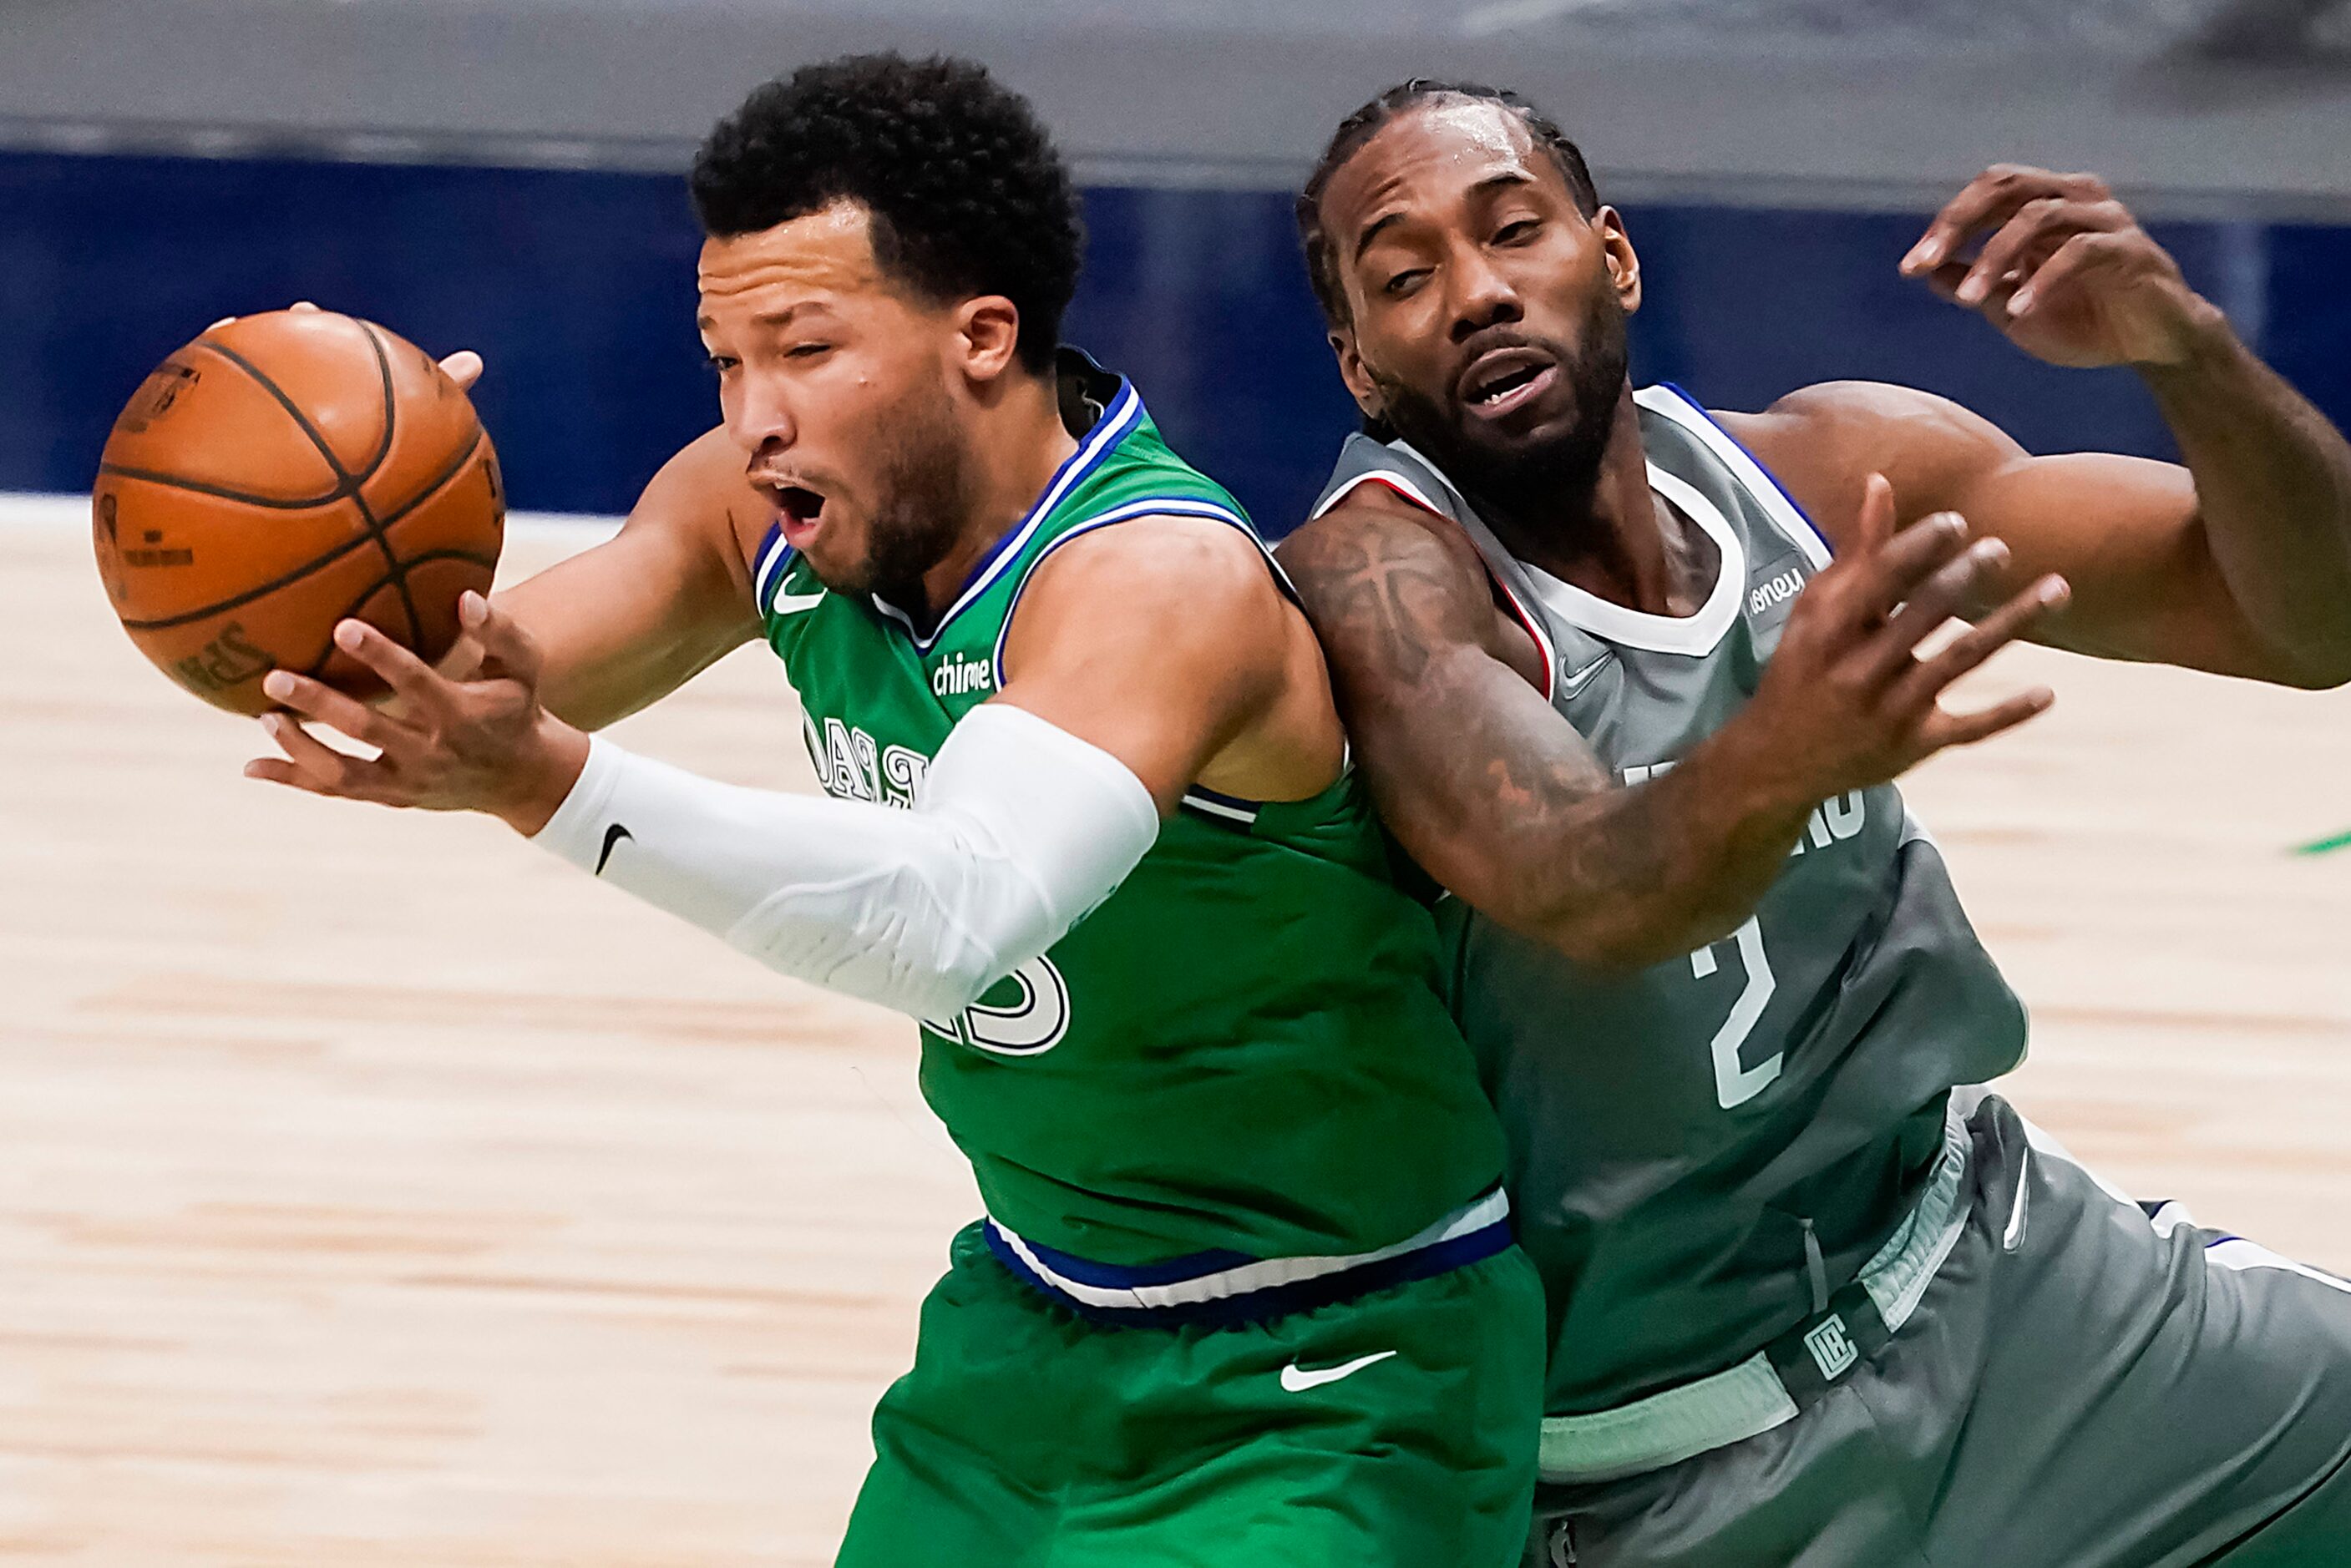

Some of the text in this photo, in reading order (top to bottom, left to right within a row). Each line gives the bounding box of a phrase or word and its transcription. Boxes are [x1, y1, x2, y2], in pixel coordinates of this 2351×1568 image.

[1749, 567, 1806, 615] oney
[933, 651, 991, 697] chime
[1690, 913, 1784, 1110] 2
